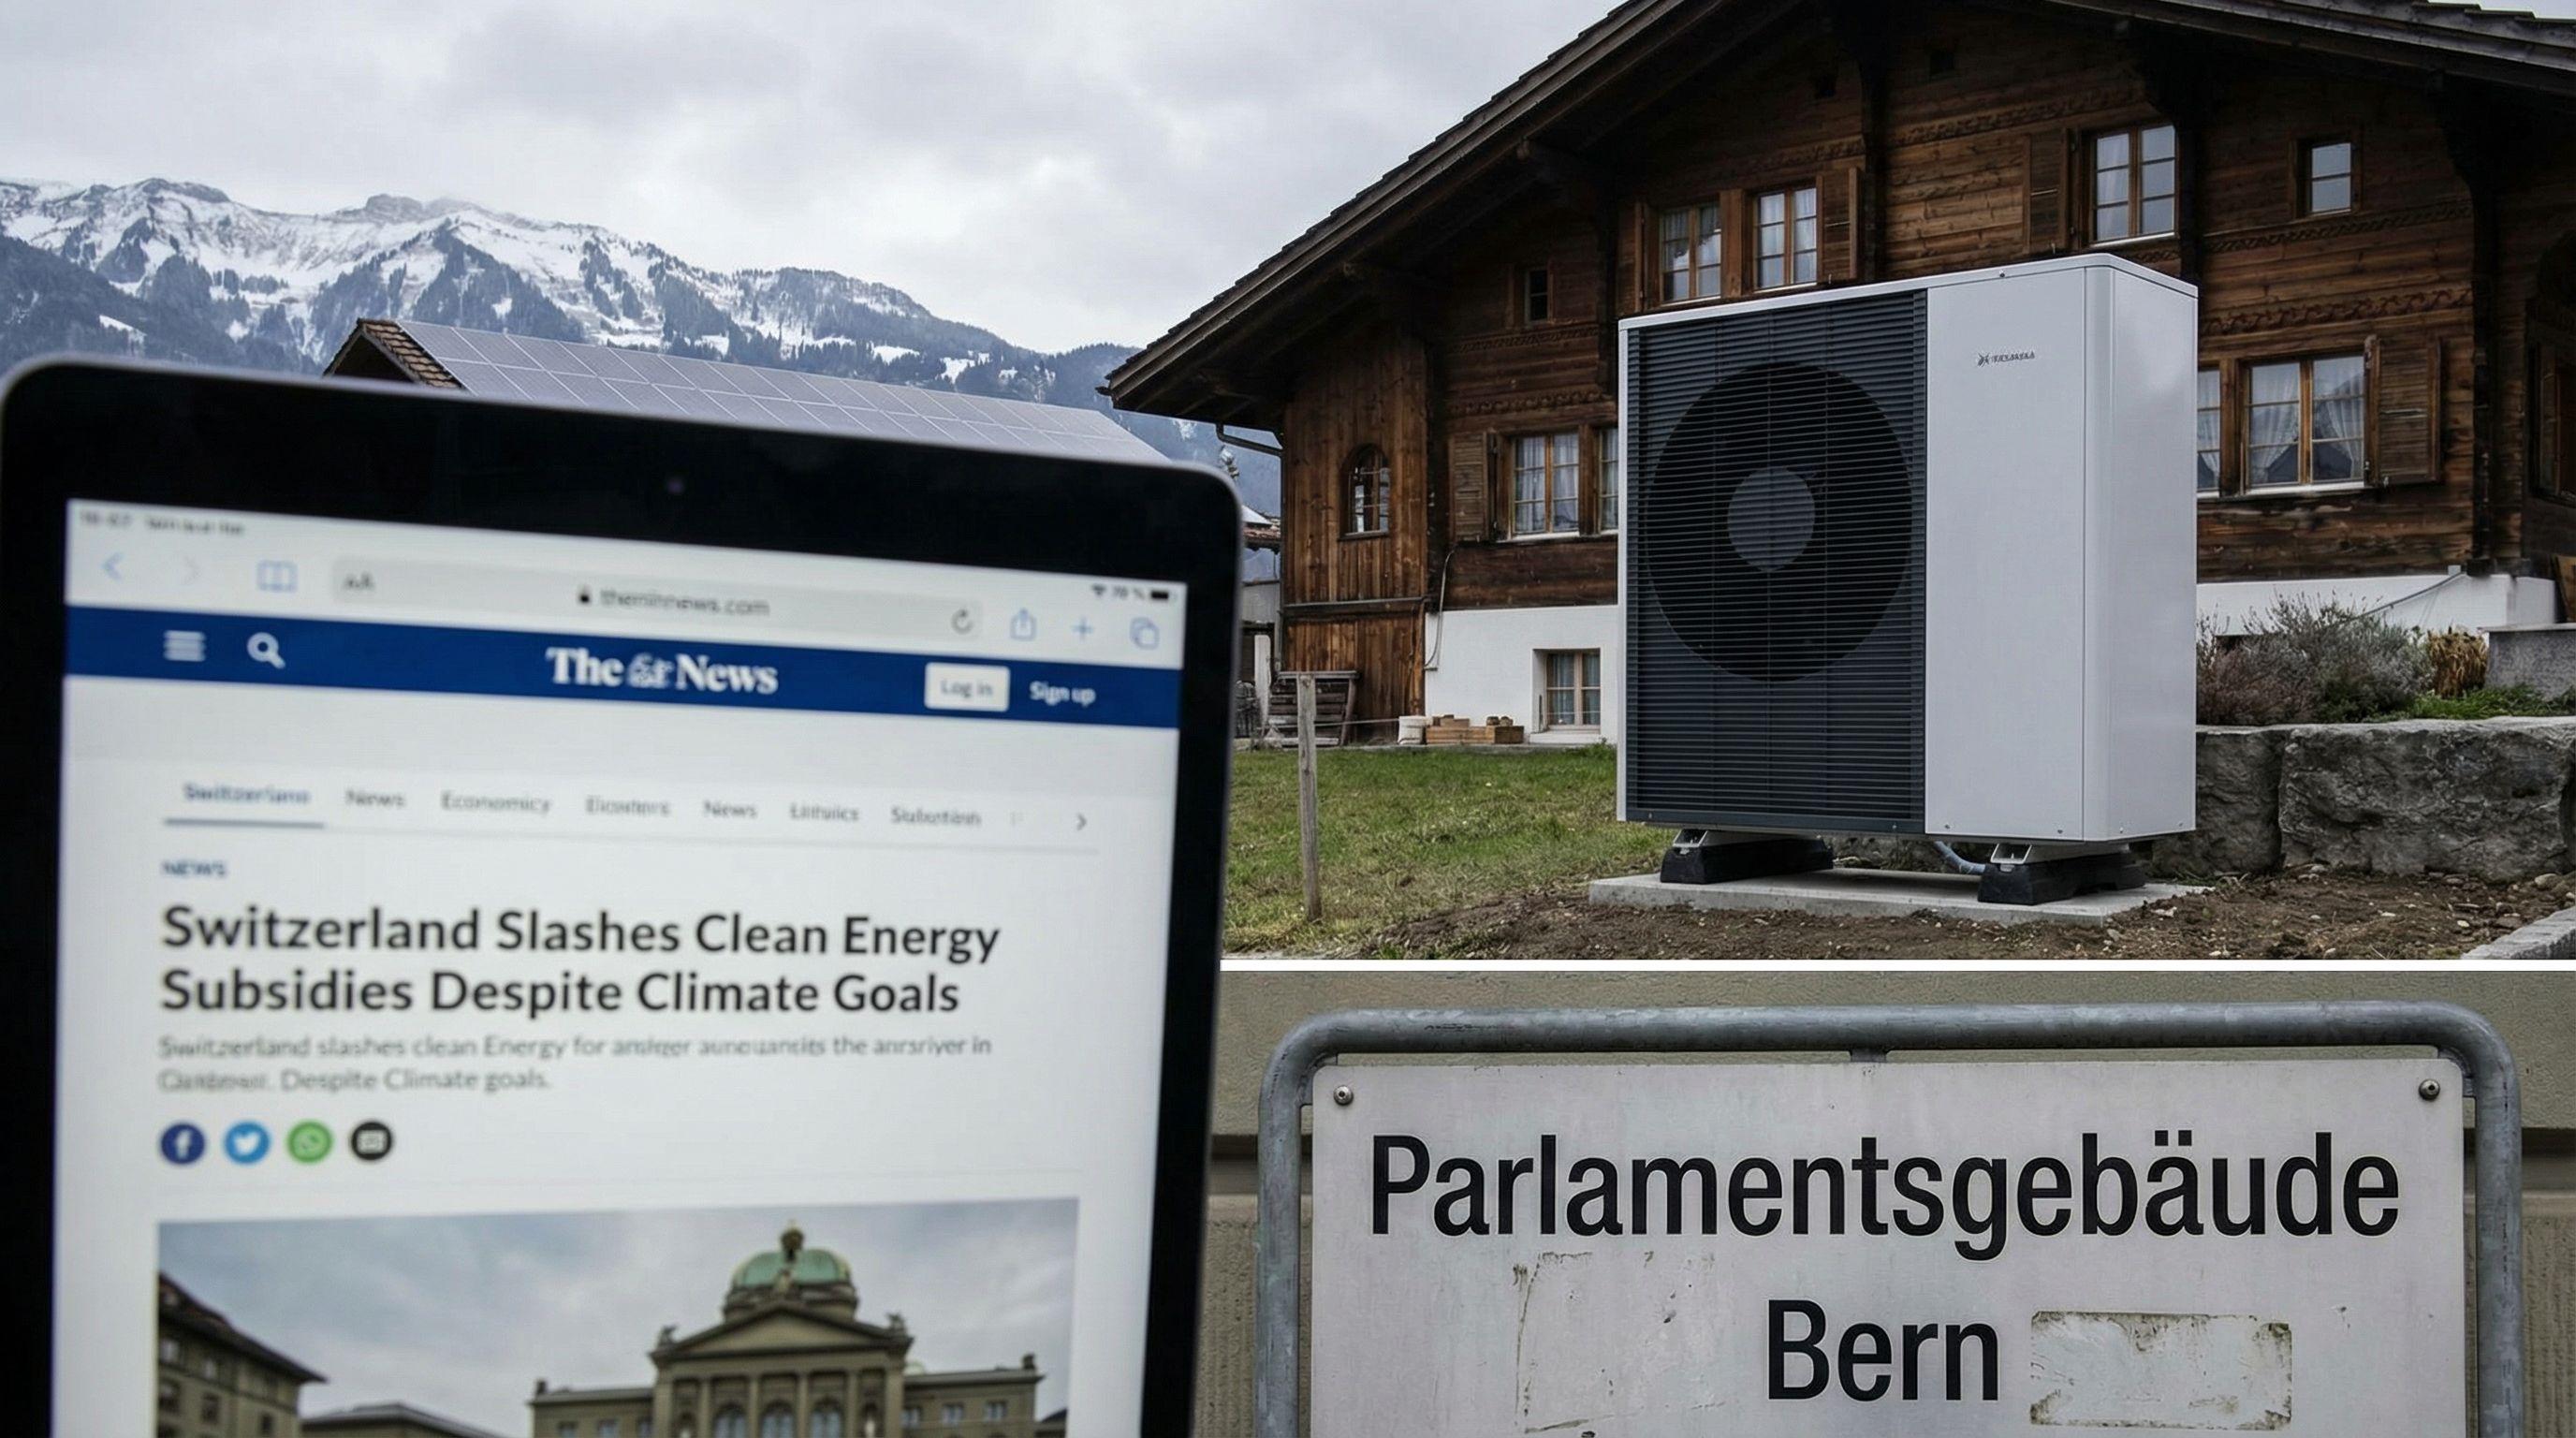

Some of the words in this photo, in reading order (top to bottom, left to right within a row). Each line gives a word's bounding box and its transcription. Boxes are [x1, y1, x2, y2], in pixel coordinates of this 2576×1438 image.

[546, 646, 625, 687] The
[675, 653, 779, 695] News
[1030, 681, 1070, 706] Sign
[1072, 688, 1096, 708] up
[163, 904, 479, 950] Switzerland
[496, 909, 681, 953] Slashes
[695, 912, 828, 954] Clean
[843, 916, 1001, 965] Energy
[162, 968, 413, 1011] Subsidies
[432, 971, 622, 1020] Despite
[637, 971, 819, 1012] Climate
[833, 973, 959, 1013] Goals
[158, 1034, 311, 1059] Switzerland
[317, 1035, 405, 1058] slashes
[412, 1035, 478, 1057] clean
[484, 1035, 564, 1061] Energy
[572, 1034, 607, 1056] for
[832, 1035, 869, 1056] the
[972, 1035, 993, 1055] in
[281, 1068, 377, 1093] Despite
[383, 1068, 479, 1092] Climate
[484, 1068, 550, 1094] goals.
[1371, 1129, 2400, 1261] Parlamentsgebäude
[1768, 1299, 1999, 1402] Bern
